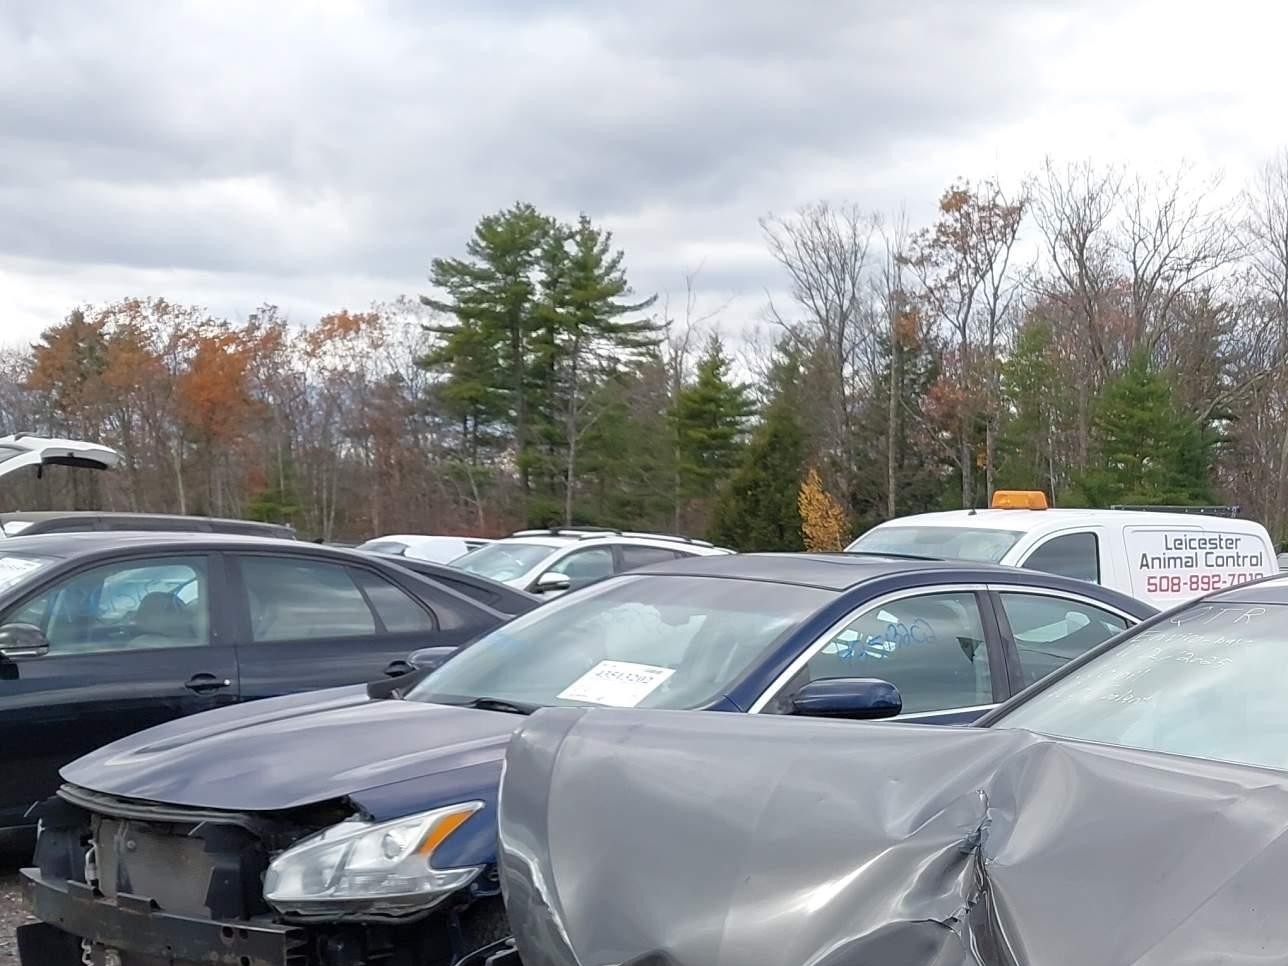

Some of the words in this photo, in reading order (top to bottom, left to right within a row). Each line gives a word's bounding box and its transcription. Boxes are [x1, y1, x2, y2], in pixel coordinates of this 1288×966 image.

[1164, 534, 1241, 550] Leicester
[1139, 552, 1198, 569] Animal
[1204, 552, 1263, 568] Control
